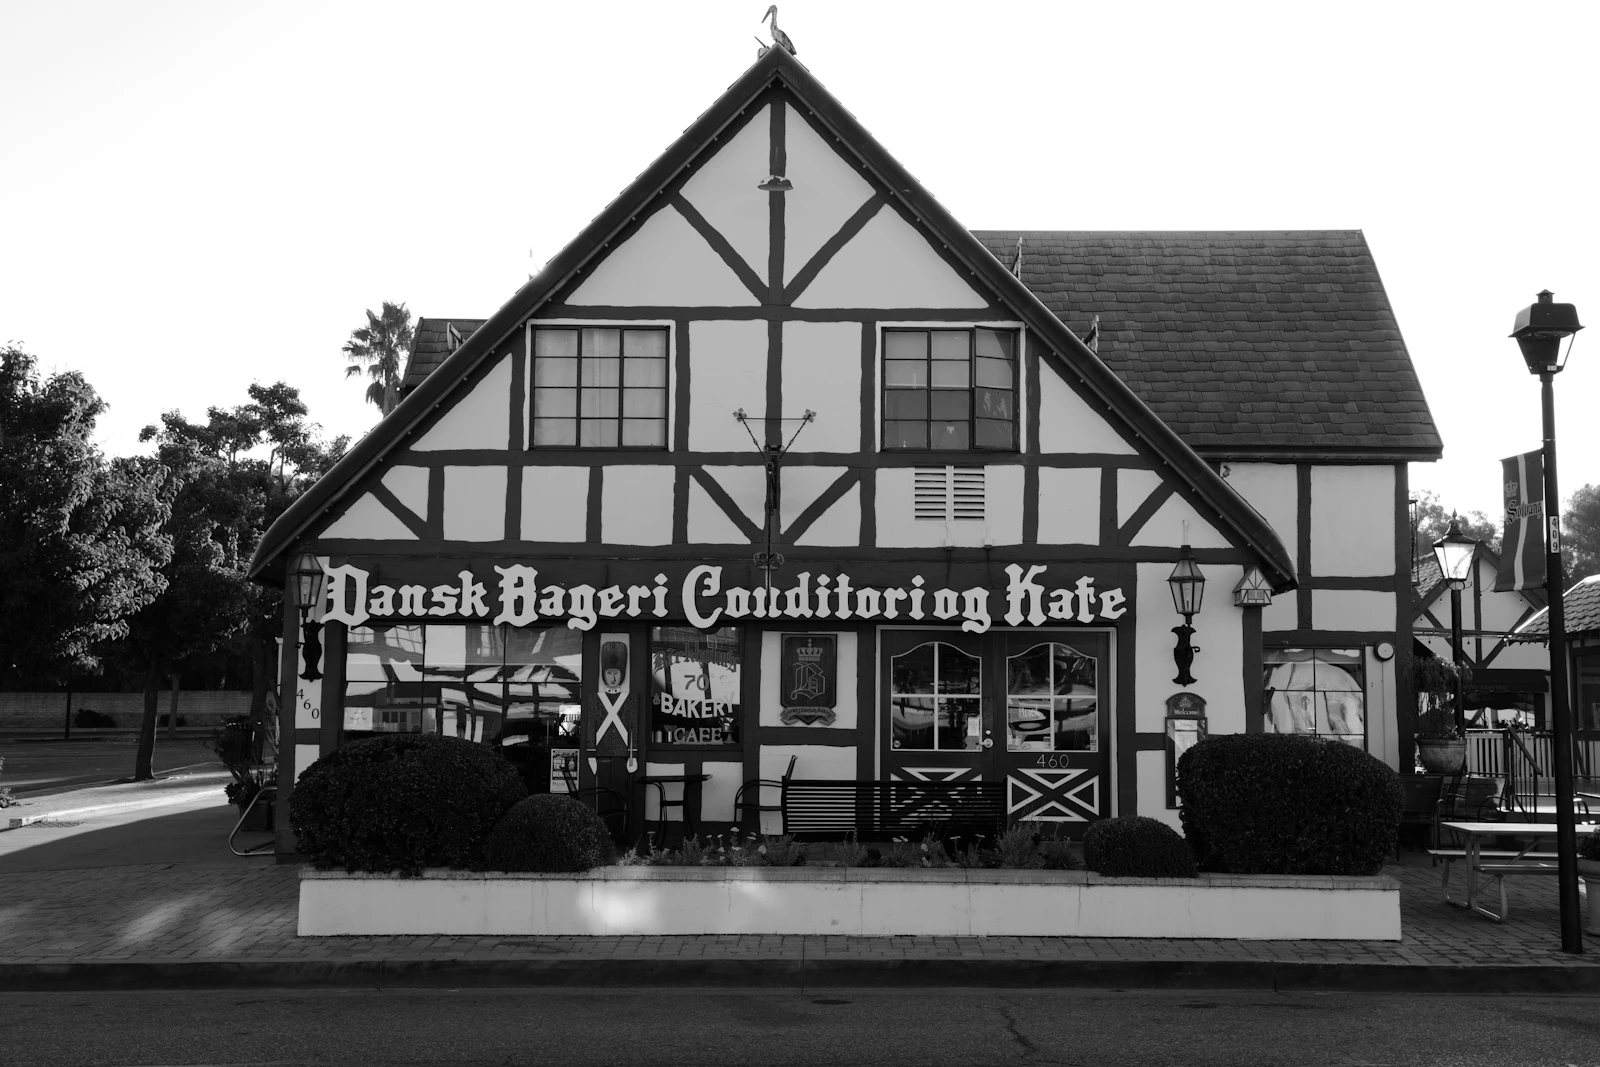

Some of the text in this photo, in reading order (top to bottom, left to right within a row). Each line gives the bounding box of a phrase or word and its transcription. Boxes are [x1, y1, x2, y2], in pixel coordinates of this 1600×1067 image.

[320, 564, 490, 626] Dansk
[493, 564, 668, 631] Bageri
[1003, 563, 1127, 627] Kafe
[684, 674, 709, 691] 70
[296, 688, 320, 719] 460
[660, 691, 734, 719] BAKERY
[1173, 707, 1199, 715] Welcome
[673, 726, 723, 743] CAFE
[1036, 753, 1069, 768] 460
